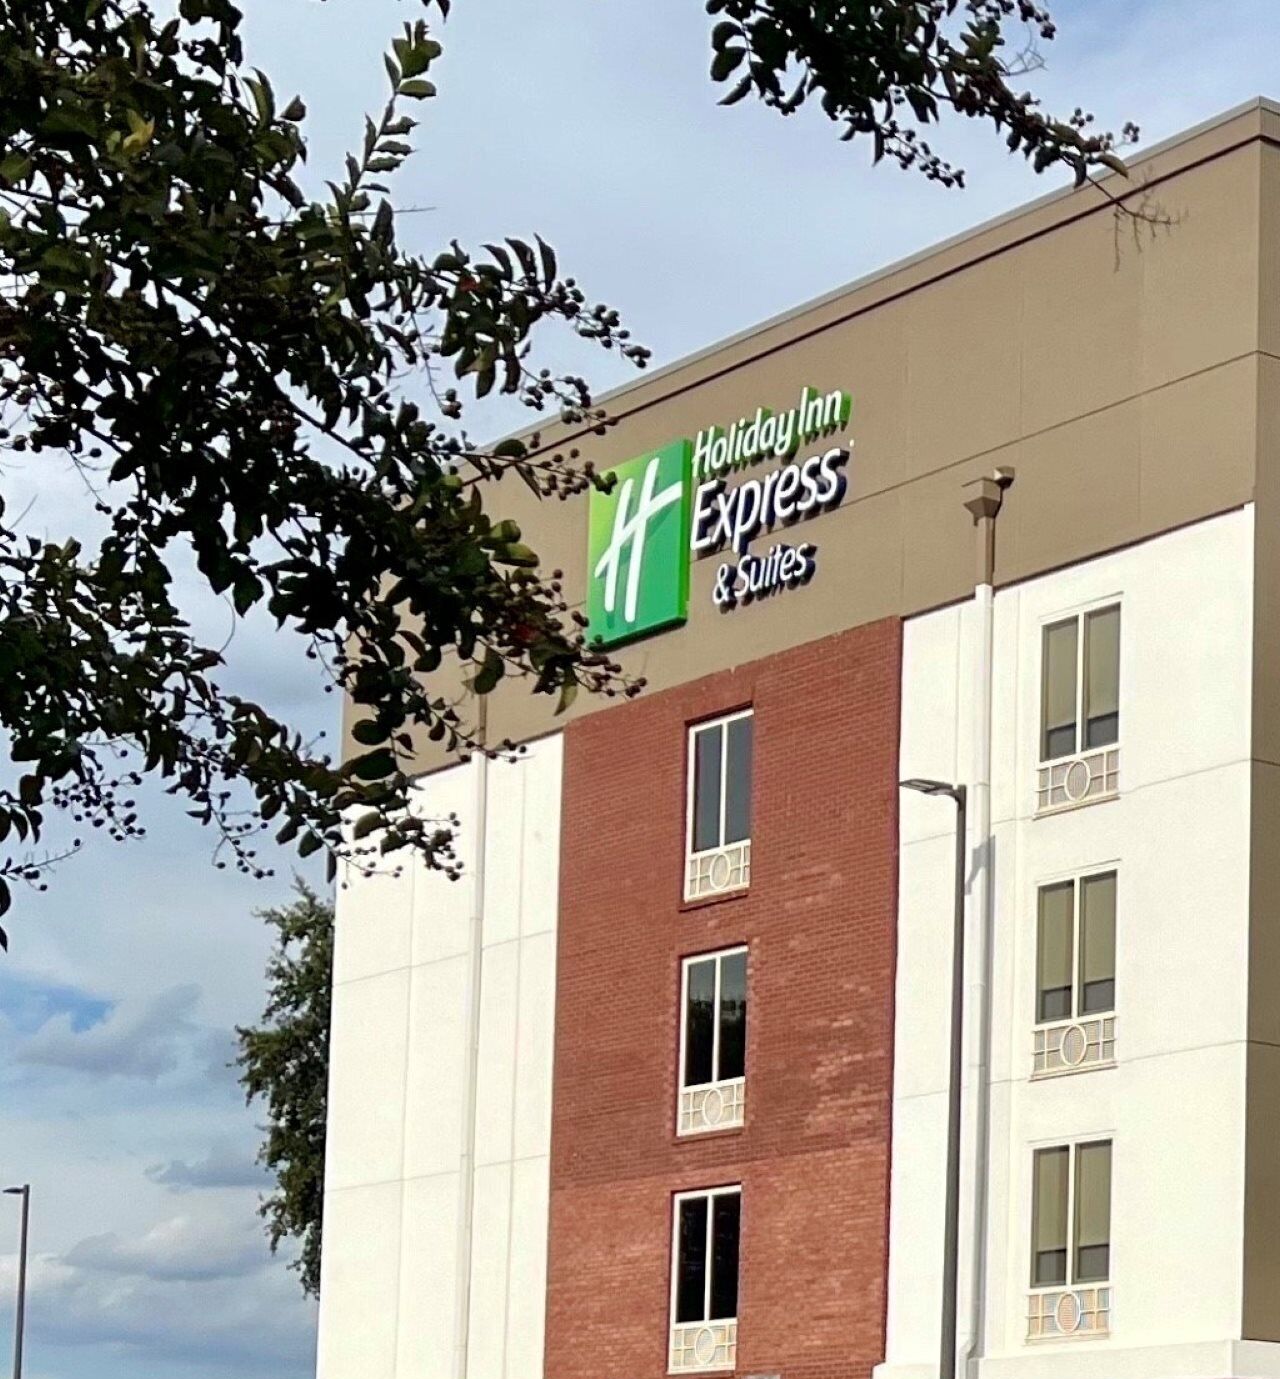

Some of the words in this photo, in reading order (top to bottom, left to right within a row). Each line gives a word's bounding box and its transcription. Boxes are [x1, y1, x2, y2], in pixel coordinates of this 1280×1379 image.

[693, 406, 799, 479] Holiday
[798, 386, 850, 440] Inn
[690, 447, 847, 553] Express
[712, 562, 735, 607] &
[734, 542, 814, 598] Suites
